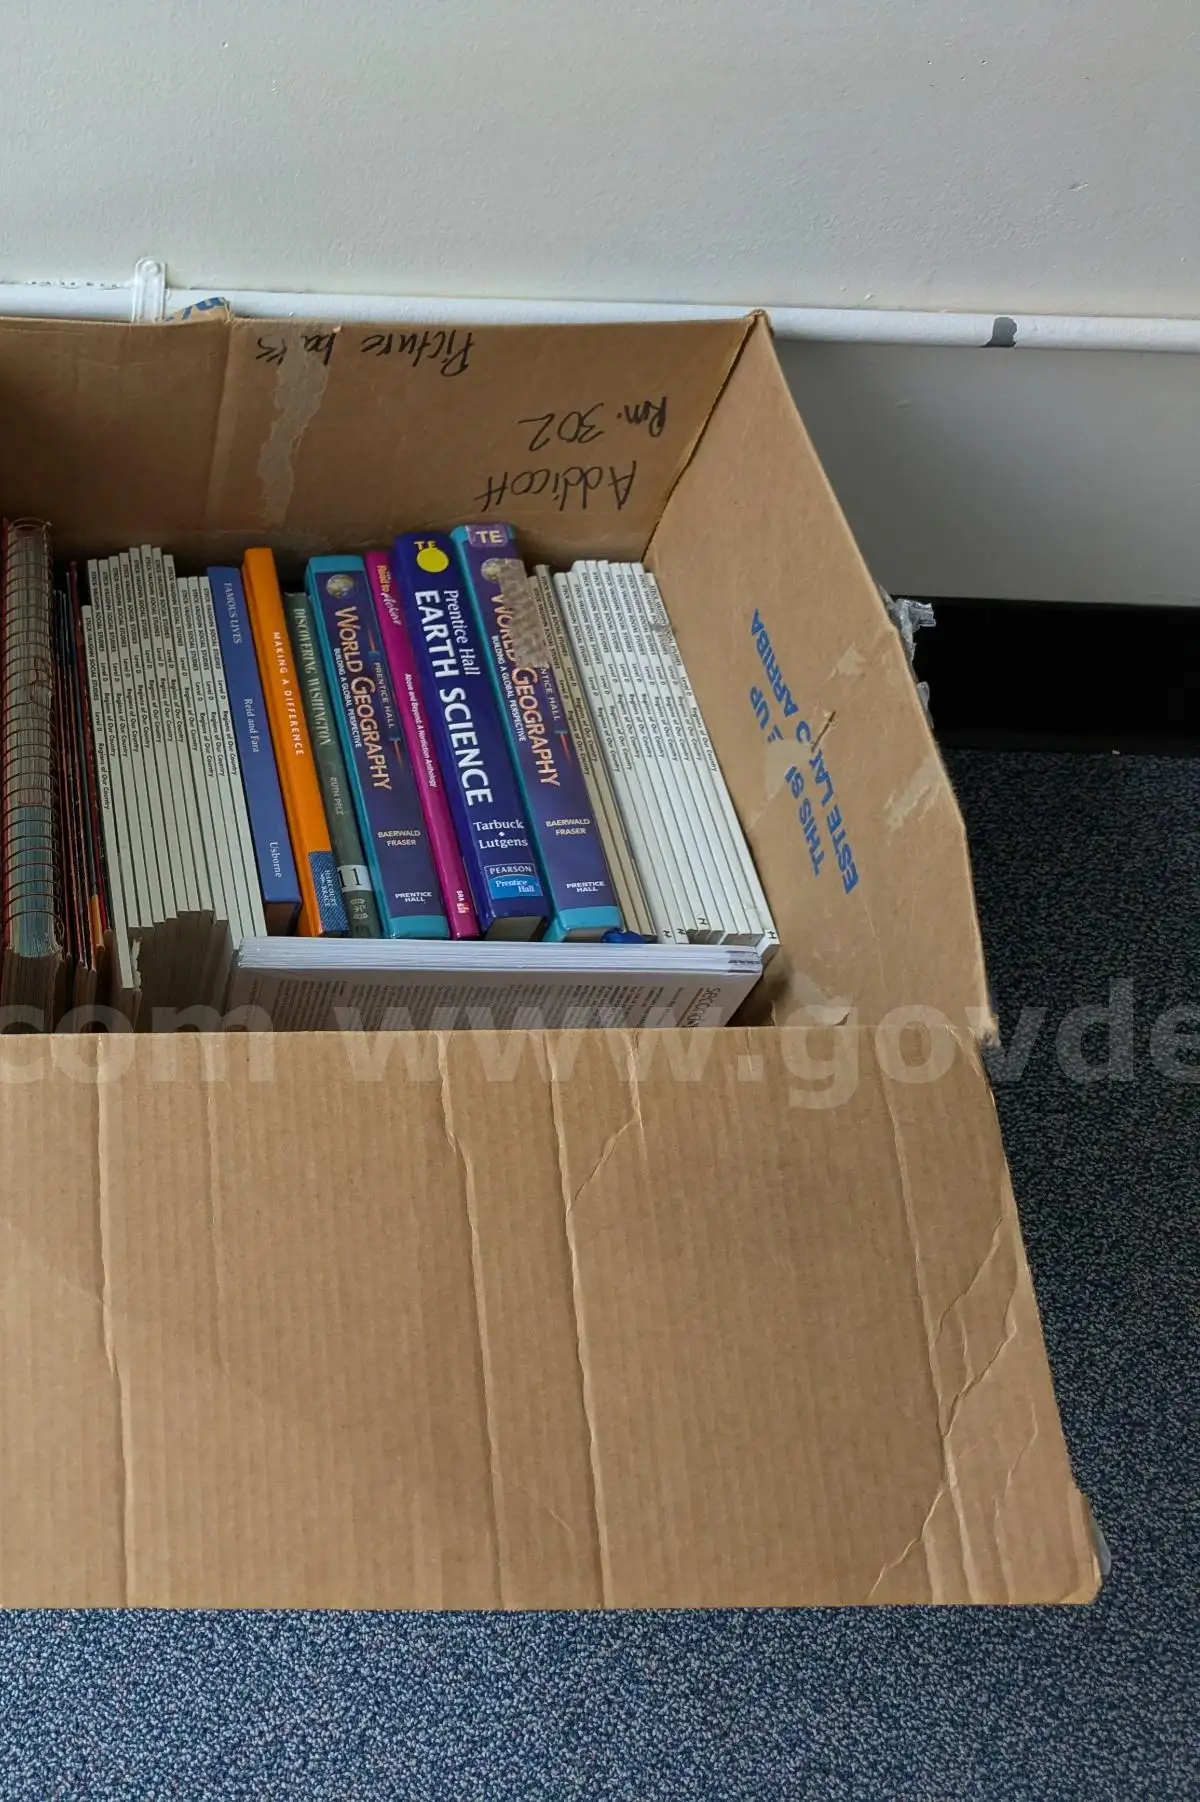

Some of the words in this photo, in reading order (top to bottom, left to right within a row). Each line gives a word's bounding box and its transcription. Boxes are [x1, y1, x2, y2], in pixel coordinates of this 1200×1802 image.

[362, 330, 475, 376] Picture
[518, 401, 604, 451] 302
[474, 460, 637, 511] Addicott
[414, 540, 437, 550] TE
[475, 530, 504, 544] TE
[223, 581, 237, 618] FAMOUS
[230, 619, 241, 644] LIVES
[444, 589, 468, 643] Prentice
[459, 647, 481, 677] Hall
[603, 612, 614, 632] SOCIAL
[610, 632, 621, 653] STUDIES
[292, 607, 315, 674] DISCOVERING
[307, 677, 332, 747] WASHINGTON
[618, 662, 627, 677] Level
[750, 608, 799, 718] ARRIBA
[91, 678, 99, 701] STUDIES
[273, 630, 288, 673] MAKING
[283, 689, 304, 756] DIFFERENCE
[373, 661, 389, 703] PRENTICE
[383, 705, 395, 729] HALL
[404, 672, 414, 690] Above
[408, 690, 416, 702] and
[491, 634, 505, 664] BUILDING
[501, 671, 514, 697] GLOBAL
[508, 698, 525, 741] PERSPECTIVE
[243, 696, 255, 717] Reid
[333, 647, 345, 675] BUILDING
[340, 682, 352, 707] GLOBAL
[346, 708, 361, 748] PERSPECTIVE
[335, 605, 363, 674] WORLD
[352, 675, 392, 791] GEOGRAPHY
[415, 589, 458, 679] EARTH
[440, 687, 493, 806] SCIENCE
[548, 695, 560, 720] HALL
[749, 685, 771, 730] UP
[247, 717, 258, 733] and
[515, 666, 561, 787] GEOGRAPHY
[627, 692, 640, 714] Regions
[640, 734, 654, 759] Country
[97, 742, 106, 764] Regions
[417, 729, 430, 759] Nonfiction
[423, 758, 437, 788] Anthology
[766, 724, 805, 800] SIE
[101, 786, 111, 810] Country
[329, 777, 340, 796] RUTH
[377, 829, 421, 838] BAERWALD
[473, 819, 525, 831] Tarbuck
[546, 818, 590, 828] BAERWALD
[555, 828, 586, 836] FRASER
[799, 797, 825, 878] THIS
[478, 837, 528, 849] Lutgens
[826, 804, 860, 895] ESTE
[268, 840, 284, 878] Usborne
[489, 865, 532, 875] PEARSON
[395, 891, 433, 899] PRENTICE
[518, 884, 534, 893] Hall
[566, 881, 606, 889] PRENTICE
